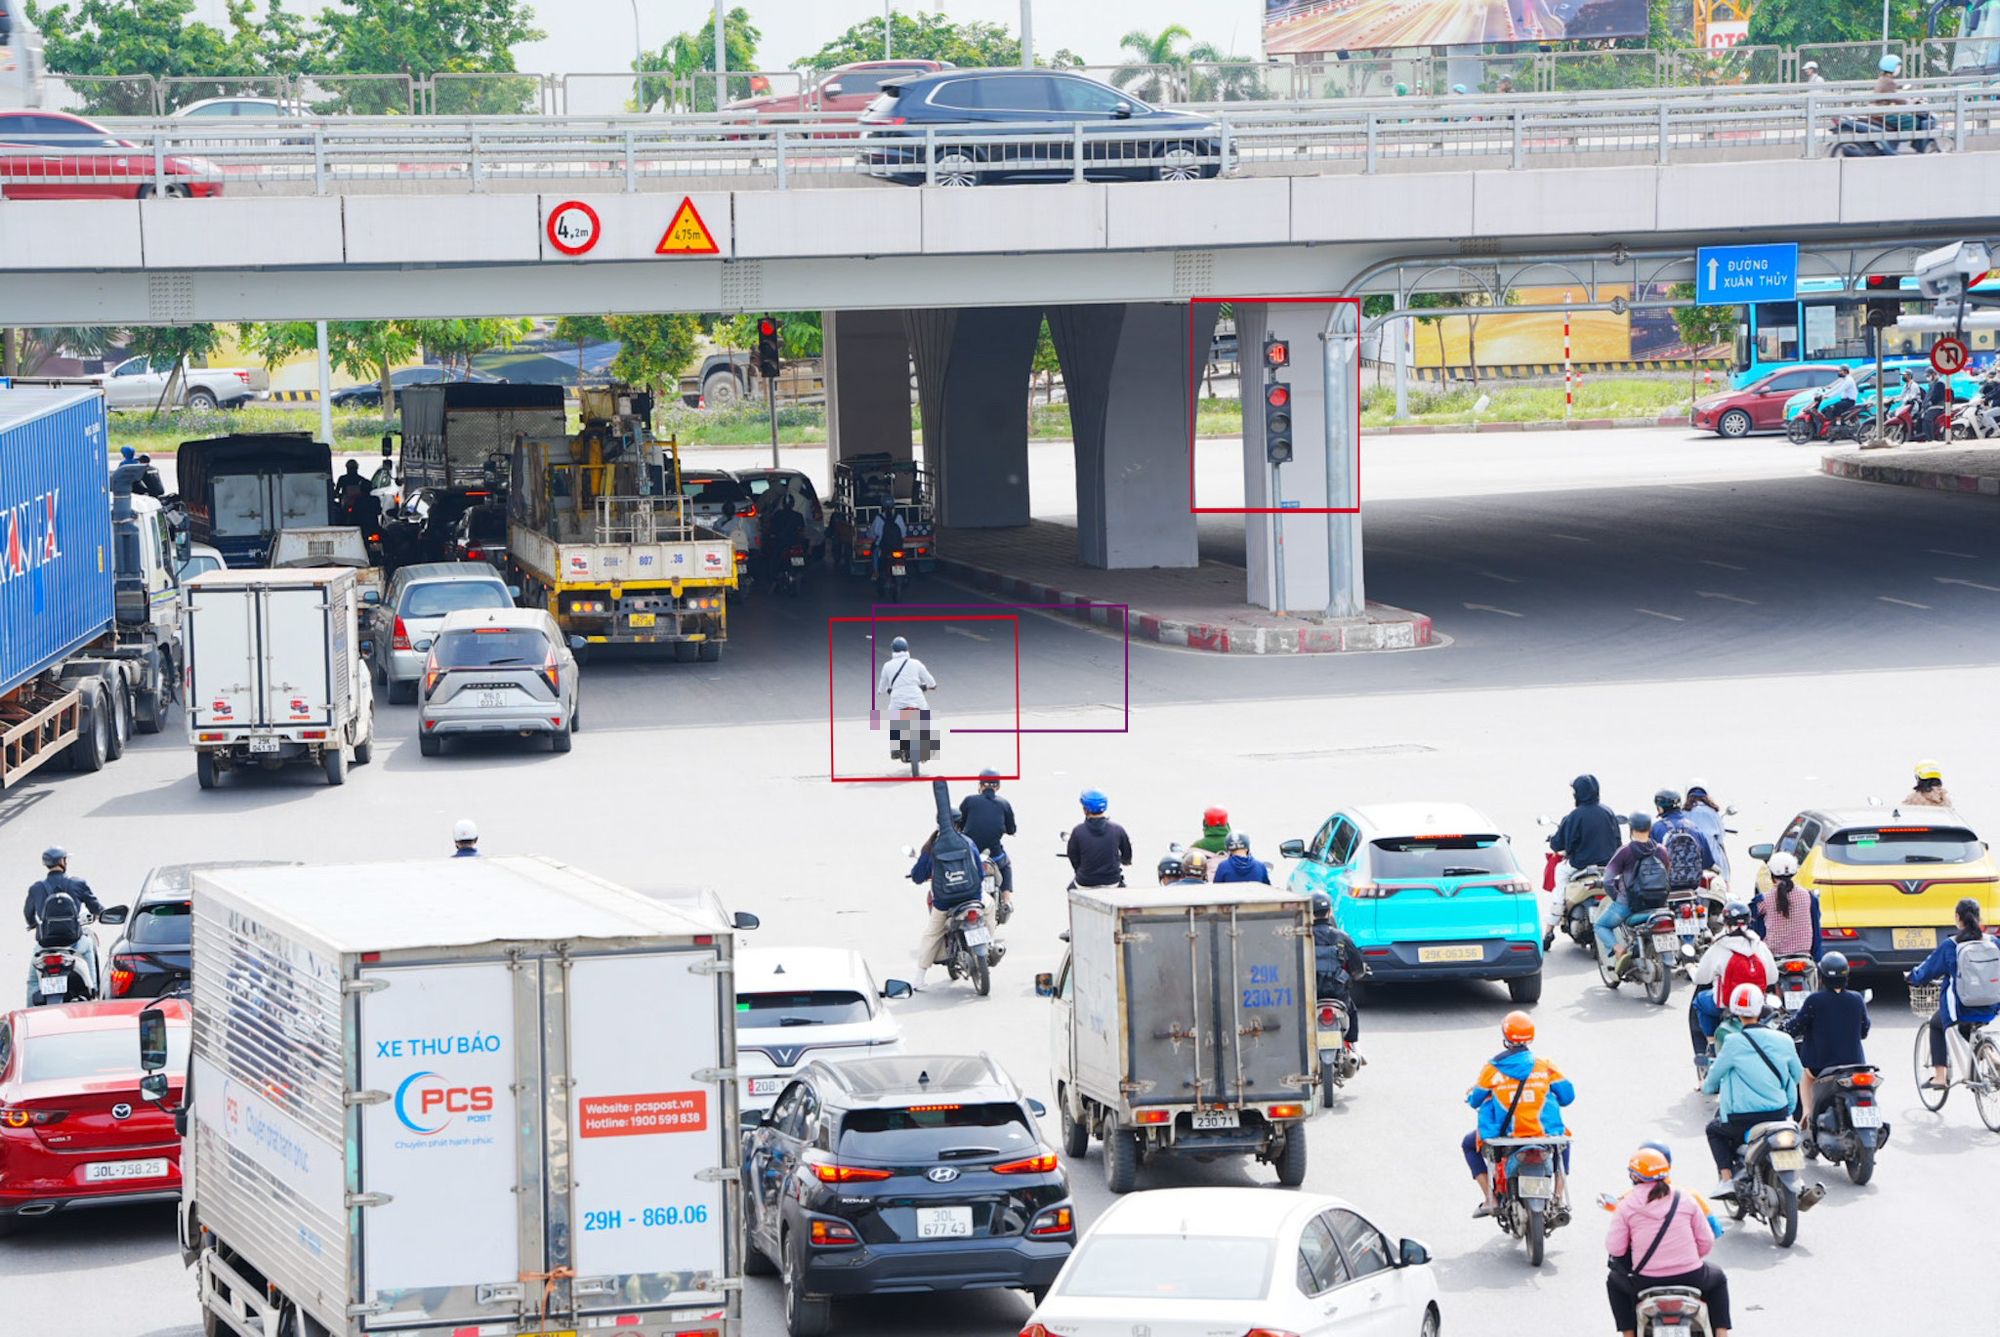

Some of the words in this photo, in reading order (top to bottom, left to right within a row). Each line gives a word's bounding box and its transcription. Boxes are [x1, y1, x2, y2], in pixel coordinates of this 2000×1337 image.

[557, 216, 589, 239] 4,2m
[674, 229, 701, 241] 4,75m
[1728, 257, 1768, 272] ĐƯỜNG
[1724, 275, 1753, 288] XUÂN
[1759, 272, 1788, 286] THỦY
[1250, 965, 1279, 985] 29K
[1243, 988, 1293, 1008] 230.71
[376, 1040, 403, 1058] XE
[407, 1036, 454, 1056] THƯ
[457, 1030, 501, 1053] BÁO
[421, 1086, 494, 1114] PCS
[585, 1102, 633, 1115] Website:
[634, 1099, 694, 1114] pcspost.vn
[467, 1114, 493, 1123] POST
[585, 1117, 629, 1130] Hotline:
[630, 1115, 657, 1127] 1900
[658, 1114, 679, 1125] 599
[680, 1112, 701, 1124] 838
[1197, 1116, 1234, 1127] 230.71
[93, 1162, 160, 1177] 30L-758.25
[584, 1210, 622, 1231] 29H
[933, 1210, 955, 1222] 30L
[924, 1222, 966, 1236] 677.43
